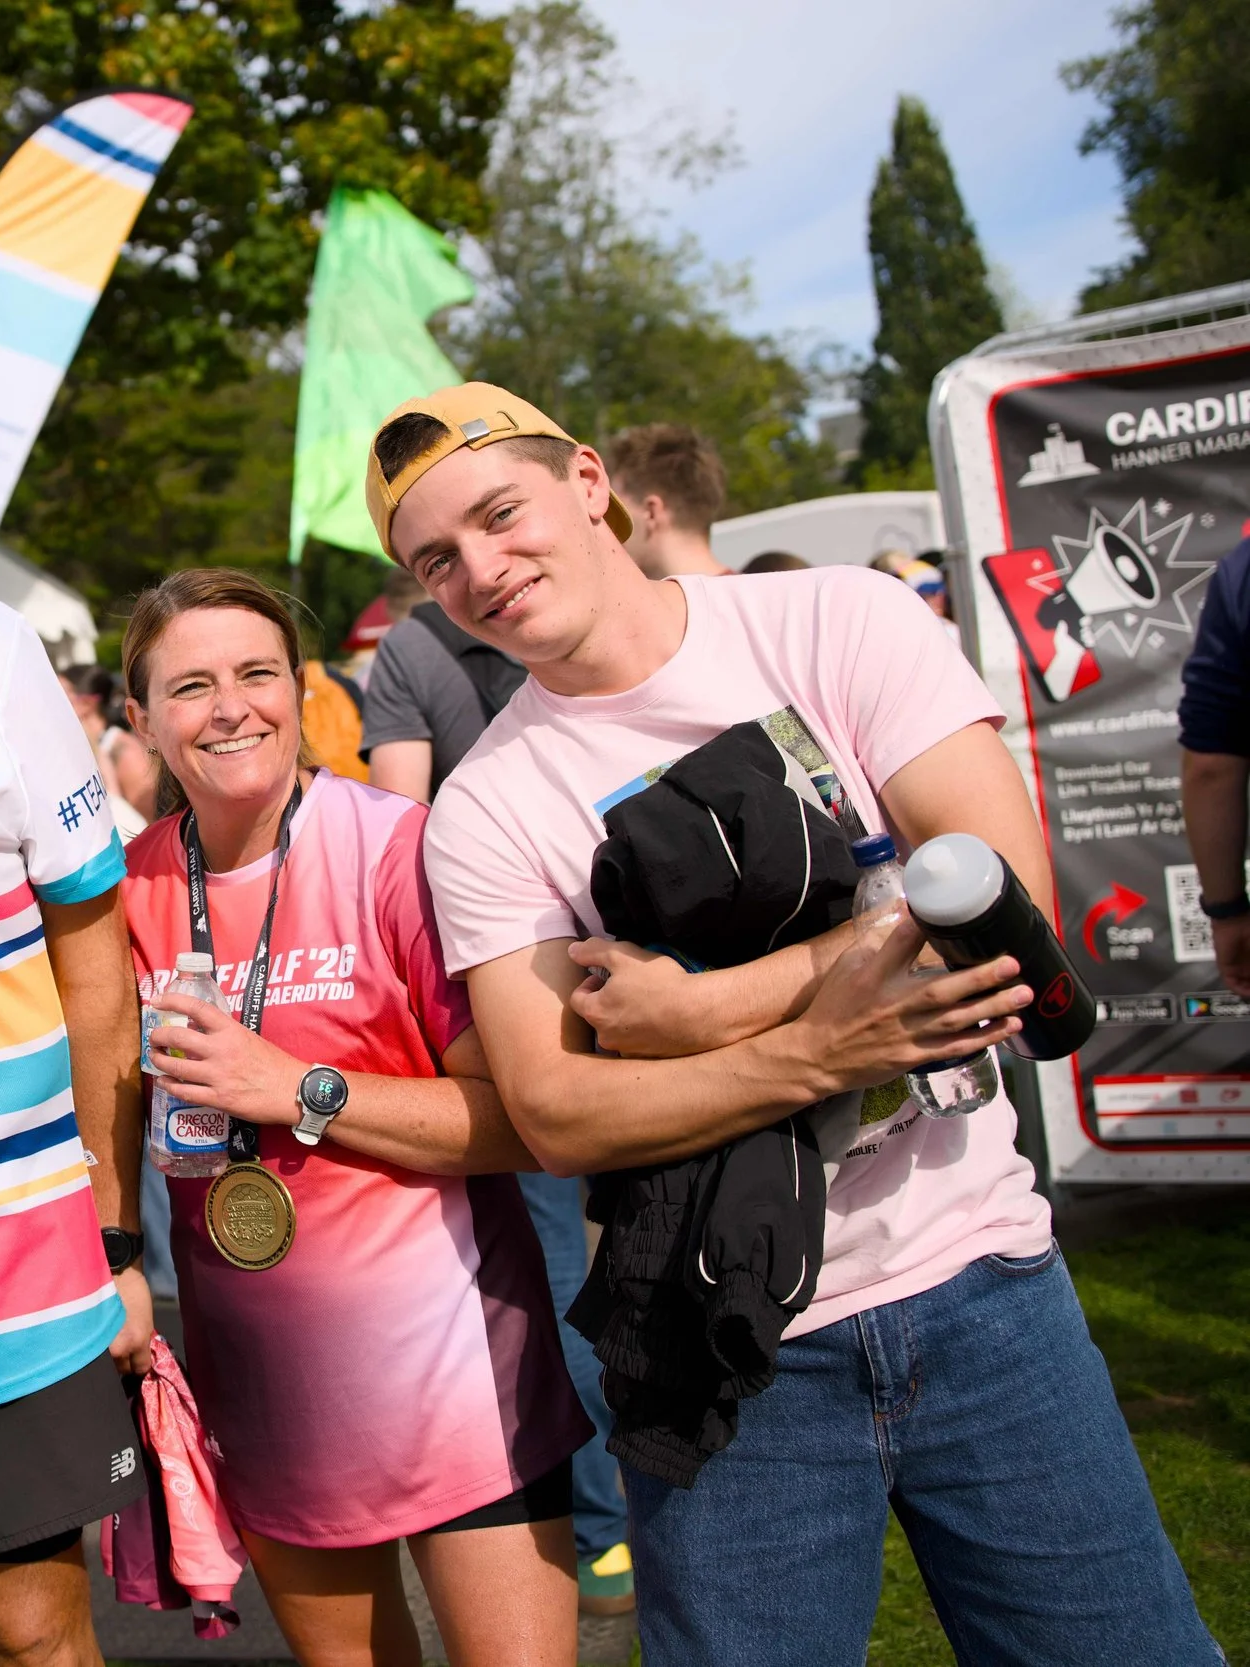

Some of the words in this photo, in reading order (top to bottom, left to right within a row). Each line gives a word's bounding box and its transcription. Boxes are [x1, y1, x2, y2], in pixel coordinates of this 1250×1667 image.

[1111, 441, 1193, 471] HANNER
[1055, 761, 1123, 782] Download
[1057, 782, 1089, 799] Live
[188, 846, 197, 873] HALF
[191, 874, 201, 915] CARDIFF
[1106, 926, 1154, 945] Scan
[1109, 944, 1140, 961] me
[250, 964, 266, 1011] CARDIFF
[177, 1112, 225, 1126] BRECON
[176, 1124, 225, 1138] CARREG
